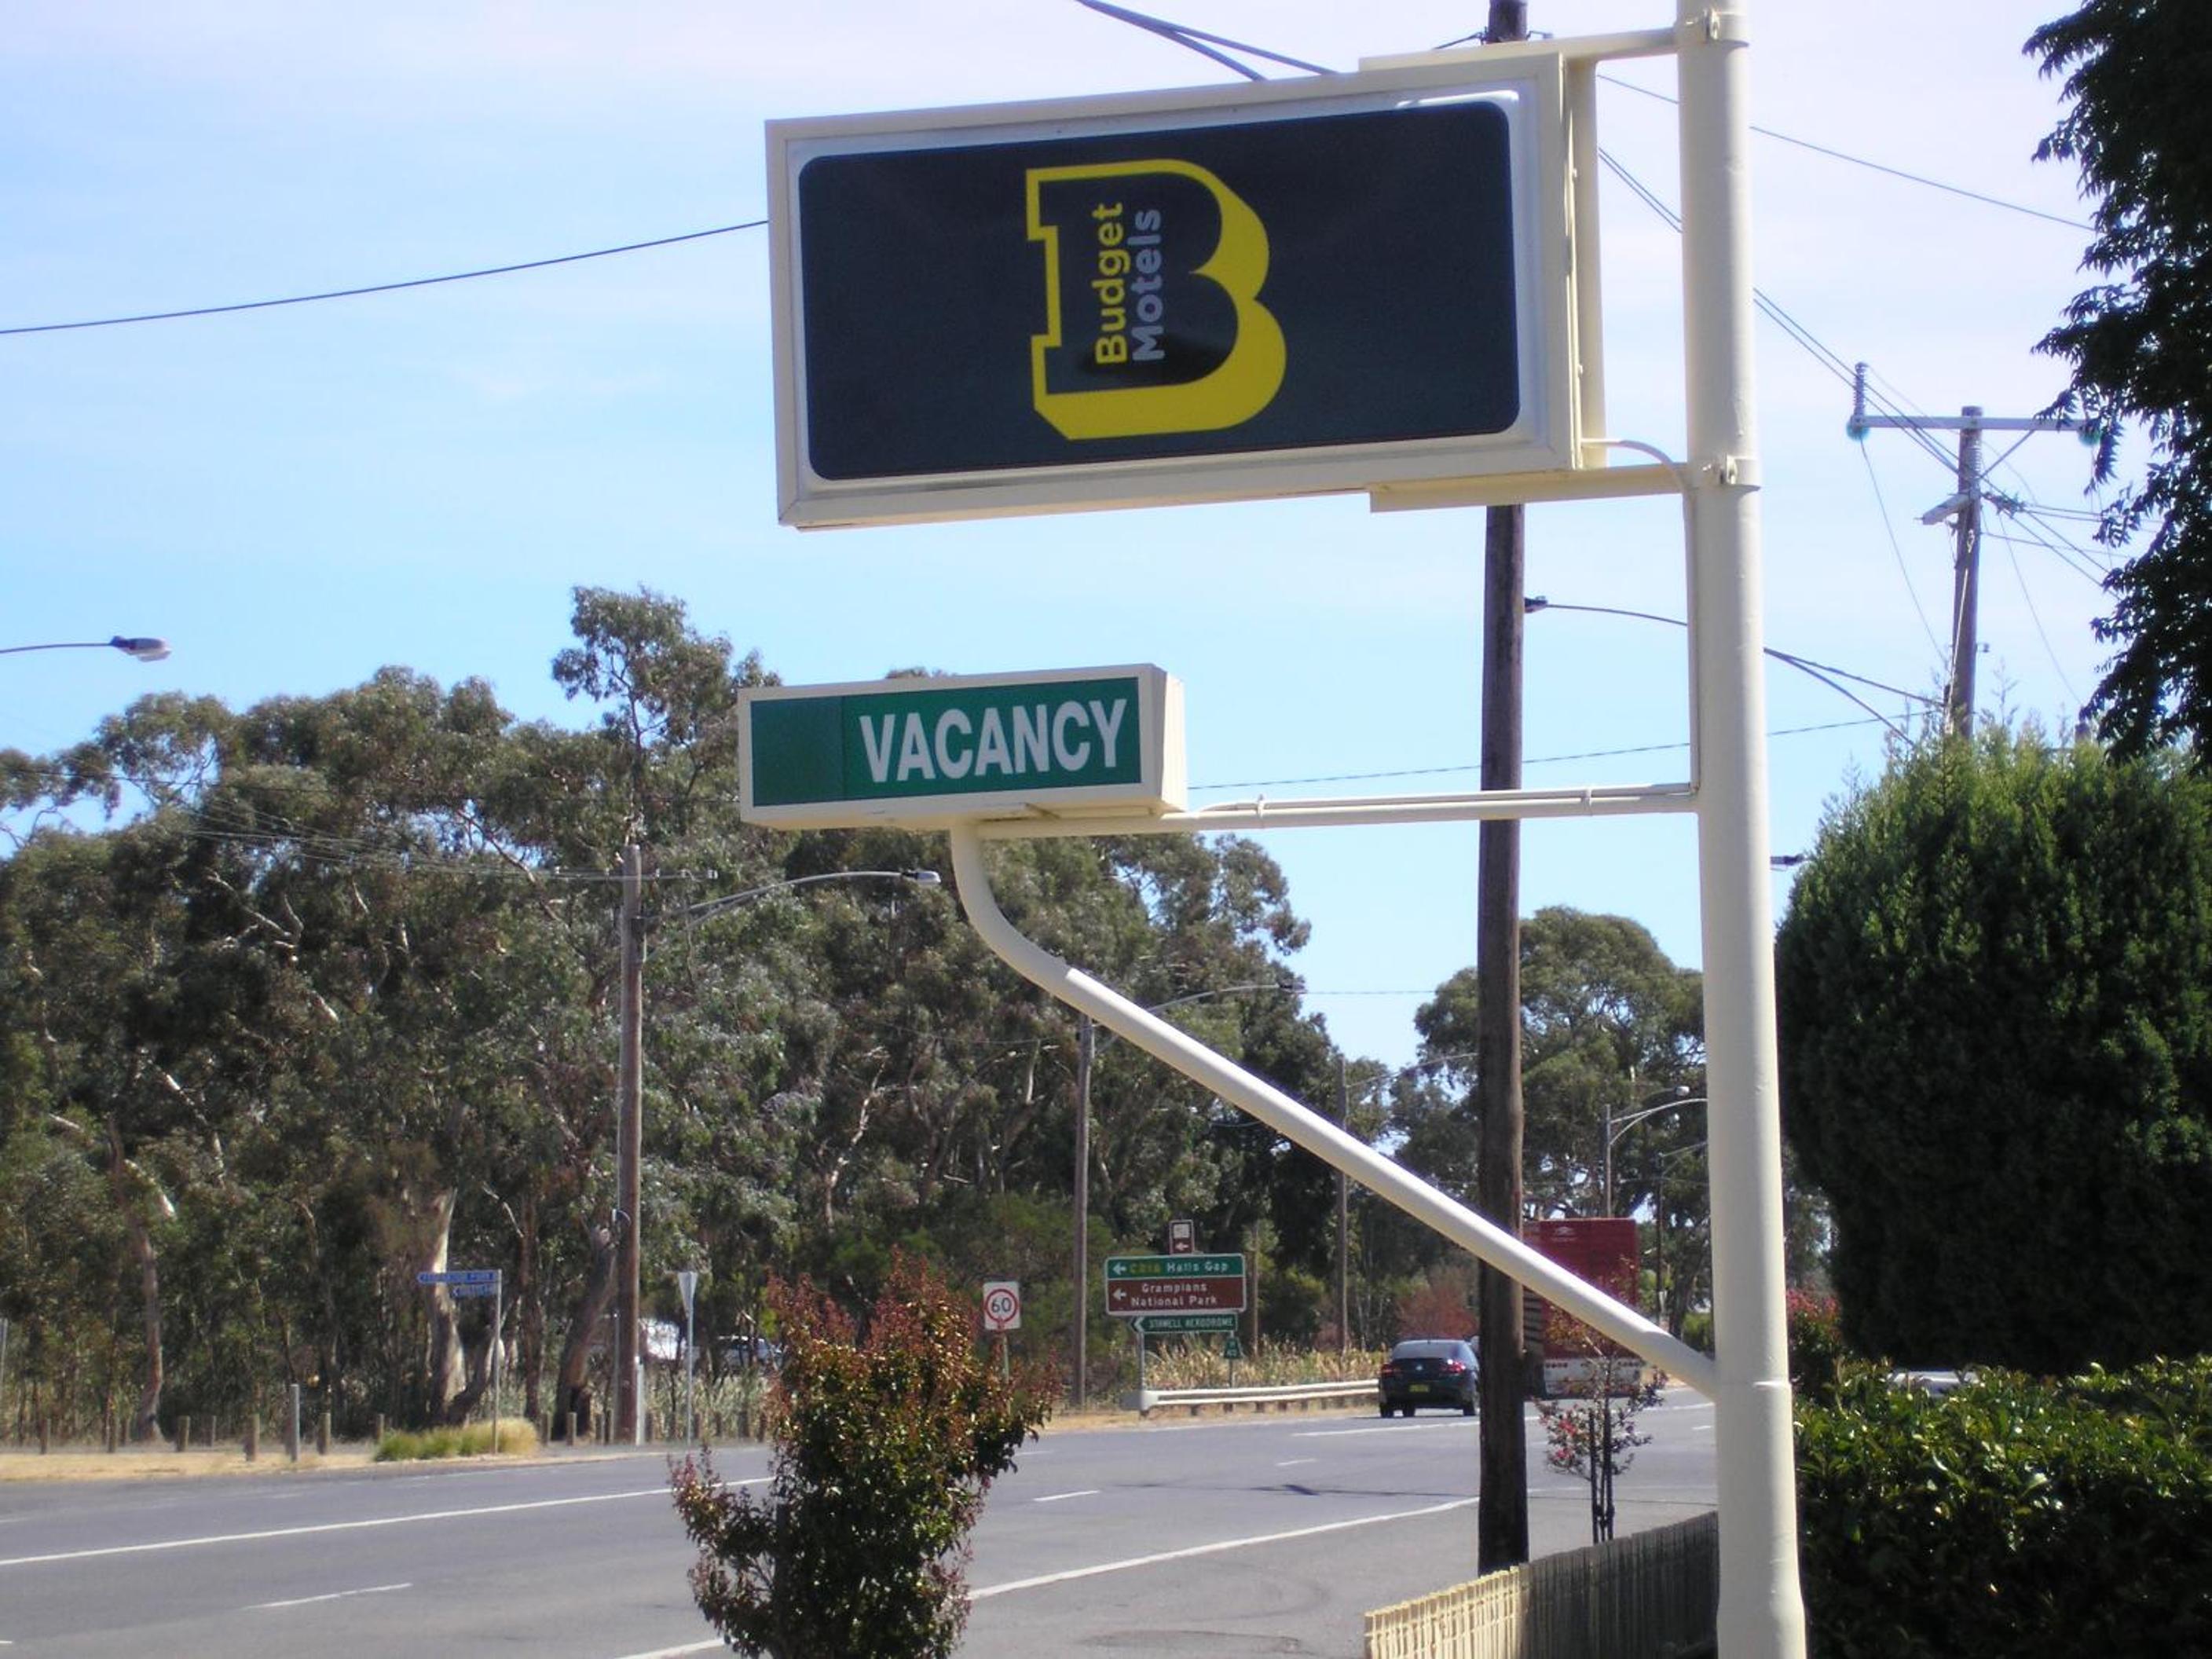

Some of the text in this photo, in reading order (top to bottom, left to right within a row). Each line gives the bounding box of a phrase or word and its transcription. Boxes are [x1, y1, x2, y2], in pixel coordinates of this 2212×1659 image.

[1092, 203, 1130, 364] Budget
[1127, 209, 1165, 361] Motels
[859, 698, 1127, 782] VACANCY
[1166, 1262, 1199, 1273] Halls
[1204, 1261, 1229, 1273] Gap
[1141, 1283, 1207, 1295] Grampians
[991, 1297, 1012, 1313] 60
[1131, 1295, 1217, 1307] National Park
